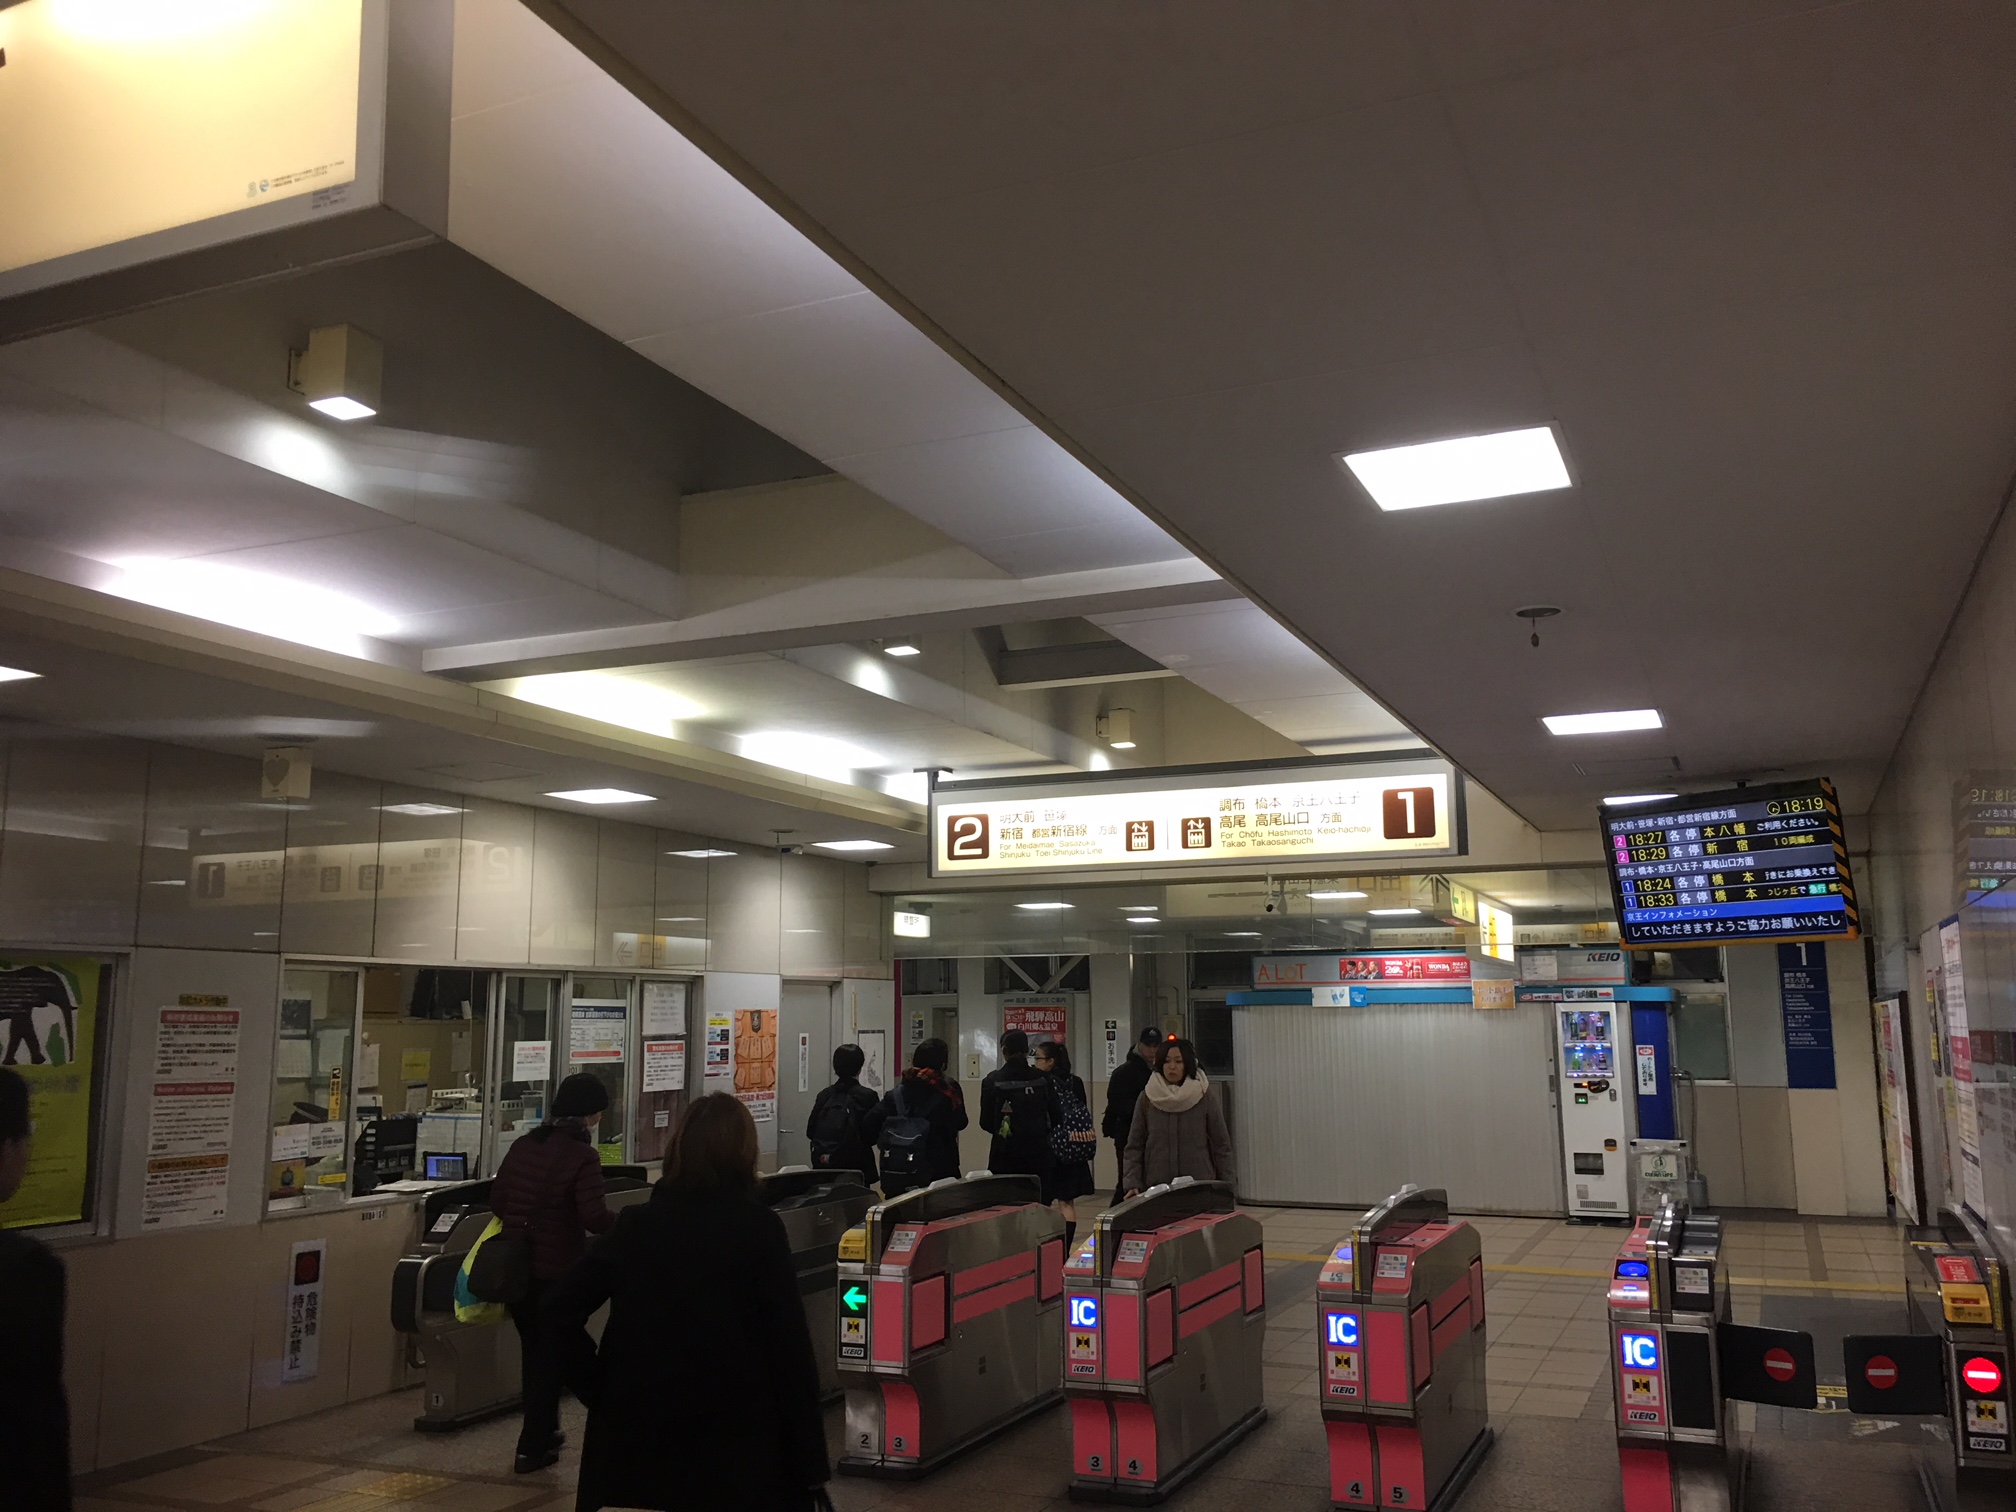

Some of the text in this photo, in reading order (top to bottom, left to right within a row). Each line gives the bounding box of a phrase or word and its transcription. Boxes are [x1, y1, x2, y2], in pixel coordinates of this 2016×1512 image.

[1219, 798, 1245, 812] 調布
[1255, 797, 1281, 810] 橋本
[1783, 797, 1824, 813] 18:19
[1000, 811, 1035, 824] 明大前
[1397, 791, 1415, 834] 1
[1219, 812, 1342, 829] 高尾 高尾山口 方面
[954, 817, 983, 856] 2
[1000, 824, 1118, 840] 新宿 都営新宿線 方面
[1267, 828, 1312, 837] Hashimoto
[1221, 837, 1314, 848] Takao Takaosanguchi
[1617, 837, 1623, 846] 2
[1628, 831, 1663, 846] 18:27
[1016, 842, 1054, 850] Meidaimae
[1059, 840, 1096, 848] Sasazuka
[1000, 851, 1031, 859] Shinjuku
[1053, 848, 1085, 857] Shinjuku
[1620, 853, 1626, 861] 2
[1631, 847, 1666, 861] 18:29
[1637, 878, 1672, 891] 18:24
[1640, 893, 1675, 907] 18:33
[1627, 909, 1718, 921] 京王インフォメーション
[1632, 915, 1841, 937] していただきますようご協力お願いいたし
[1587, 953, 1620, 962] KEIO
[1795, 943, 1807, 966] 1
[1258, 964, 1270, 981] A
[1428, 964, 1450, 972] WONDA
[1025, 1010, 1064, 1022] 飛騨高山
[1072, 1299, 1095, 1325] IC
[1329, 1315, 1357, 1343] IC
[844, 1348, 863, 1356] KEIO
[1623, 1336, 1656, 1367] IC
[1073, 1365, 1094, 1373] KEIO
[1332, 1387, 1355, 1395] KEIO
[1630, 1411, 1657, 1421] KEIO
[861, 1434, 868, 1444] 2
[895, 1438, 902, 1448] 3
[1972, 1438, 2003, 1449] KEIO
[1091, 1456, 1099, 1467] 3
[1128, 1460, 1138, 1470] 4
[1350, 1483, 1360, 1495] 4
[1393, 1487, 1403, 1499] 5
